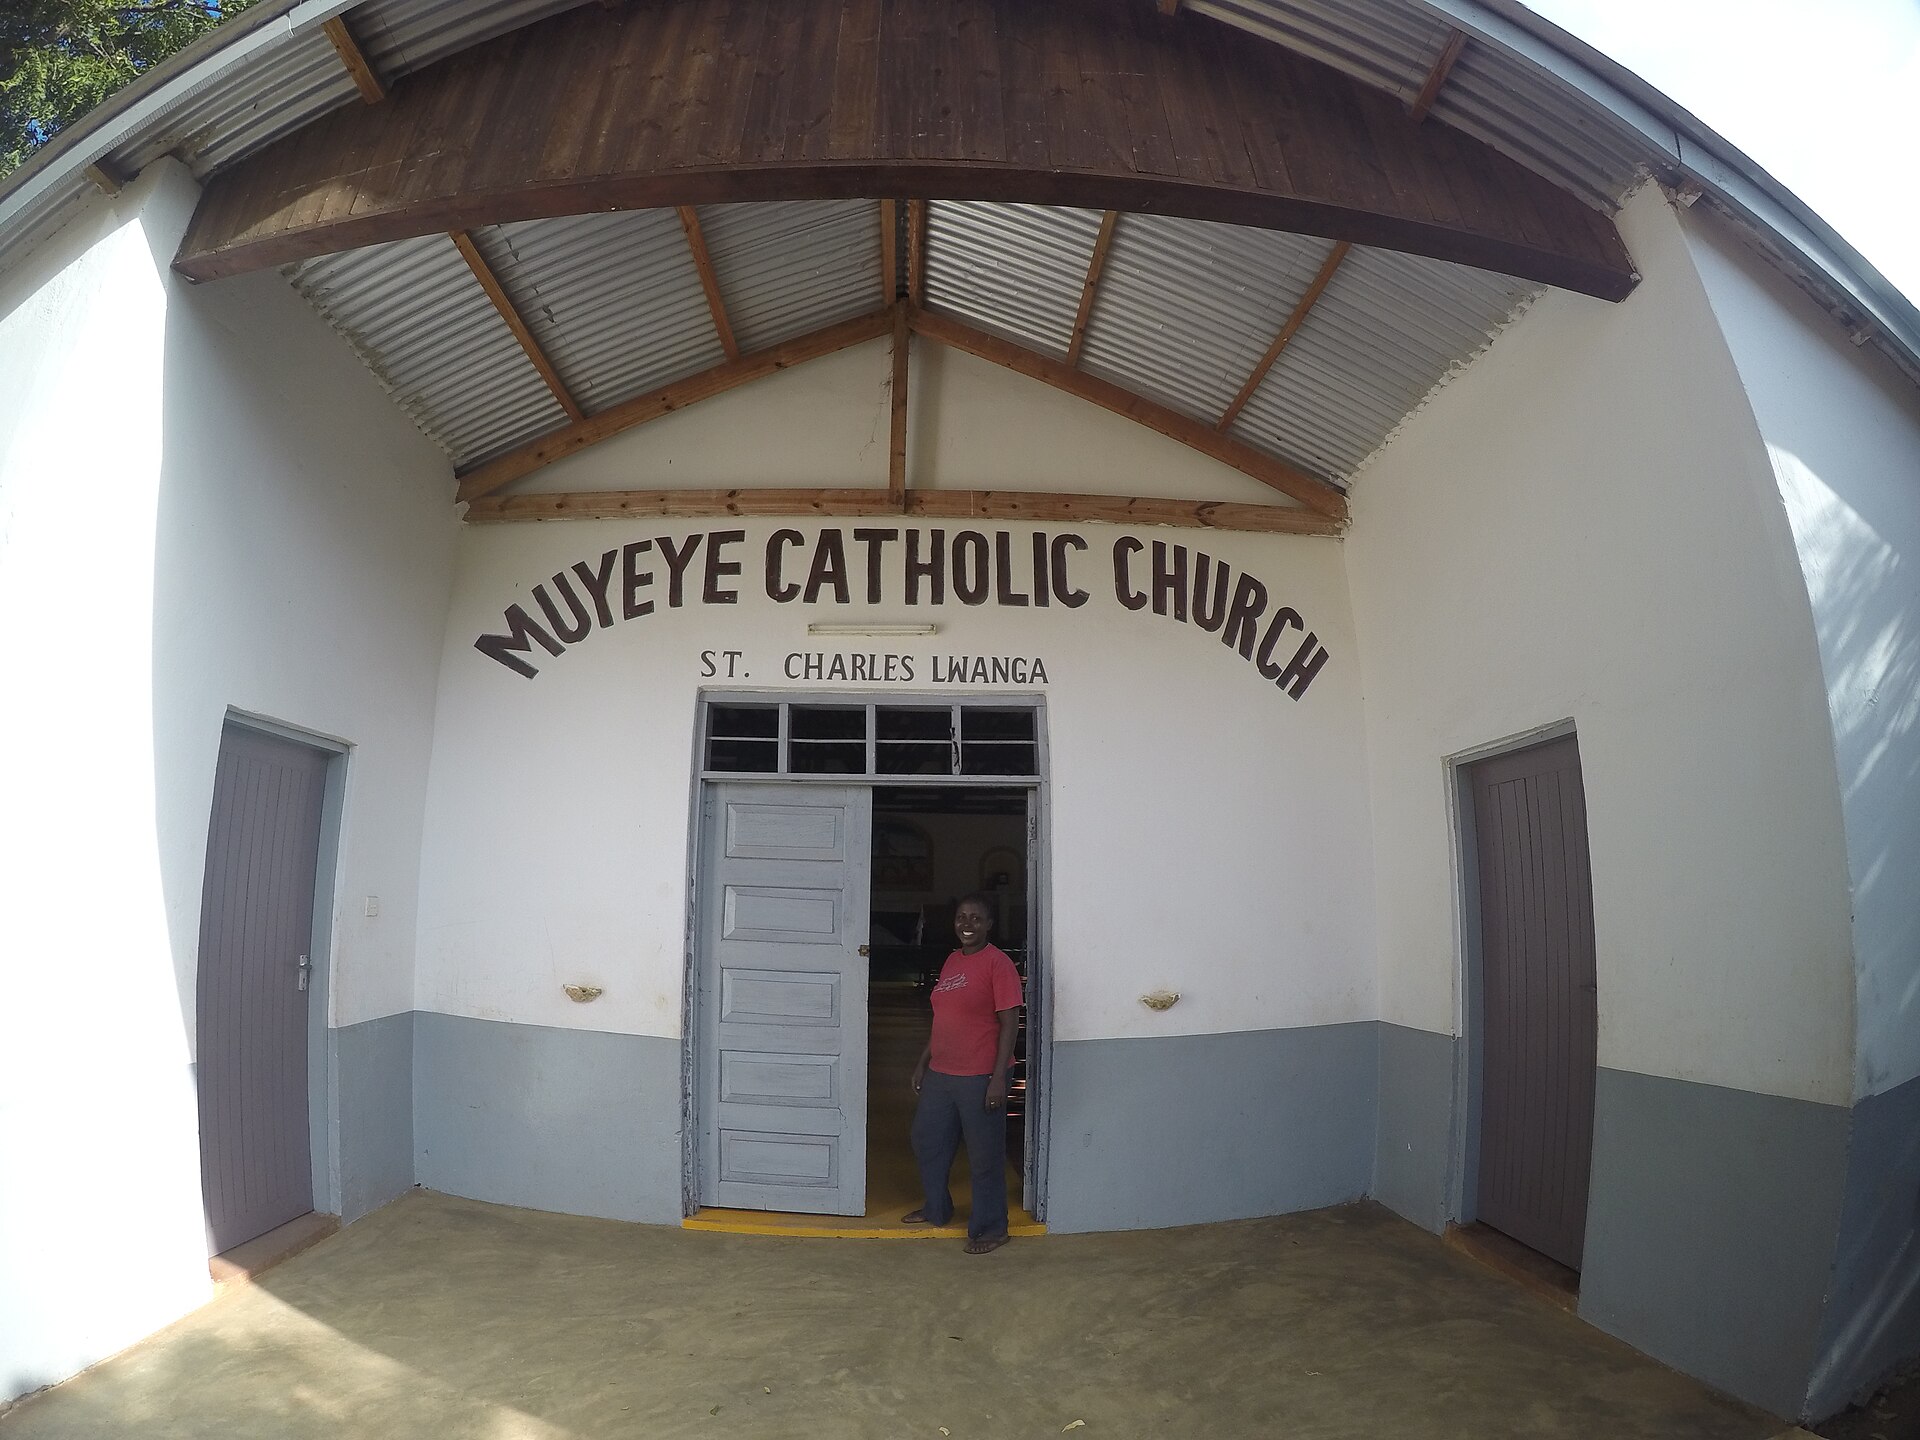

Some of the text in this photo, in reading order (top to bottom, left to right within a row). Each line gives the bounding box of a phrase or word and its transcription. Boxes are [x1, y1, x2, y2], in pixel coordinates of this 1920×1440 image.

[474, 529, 1330, 703] MUYEYE CATHOLIC CHURCH
[700, 650, 1049, 684] ST. CHARLES LWANGA
